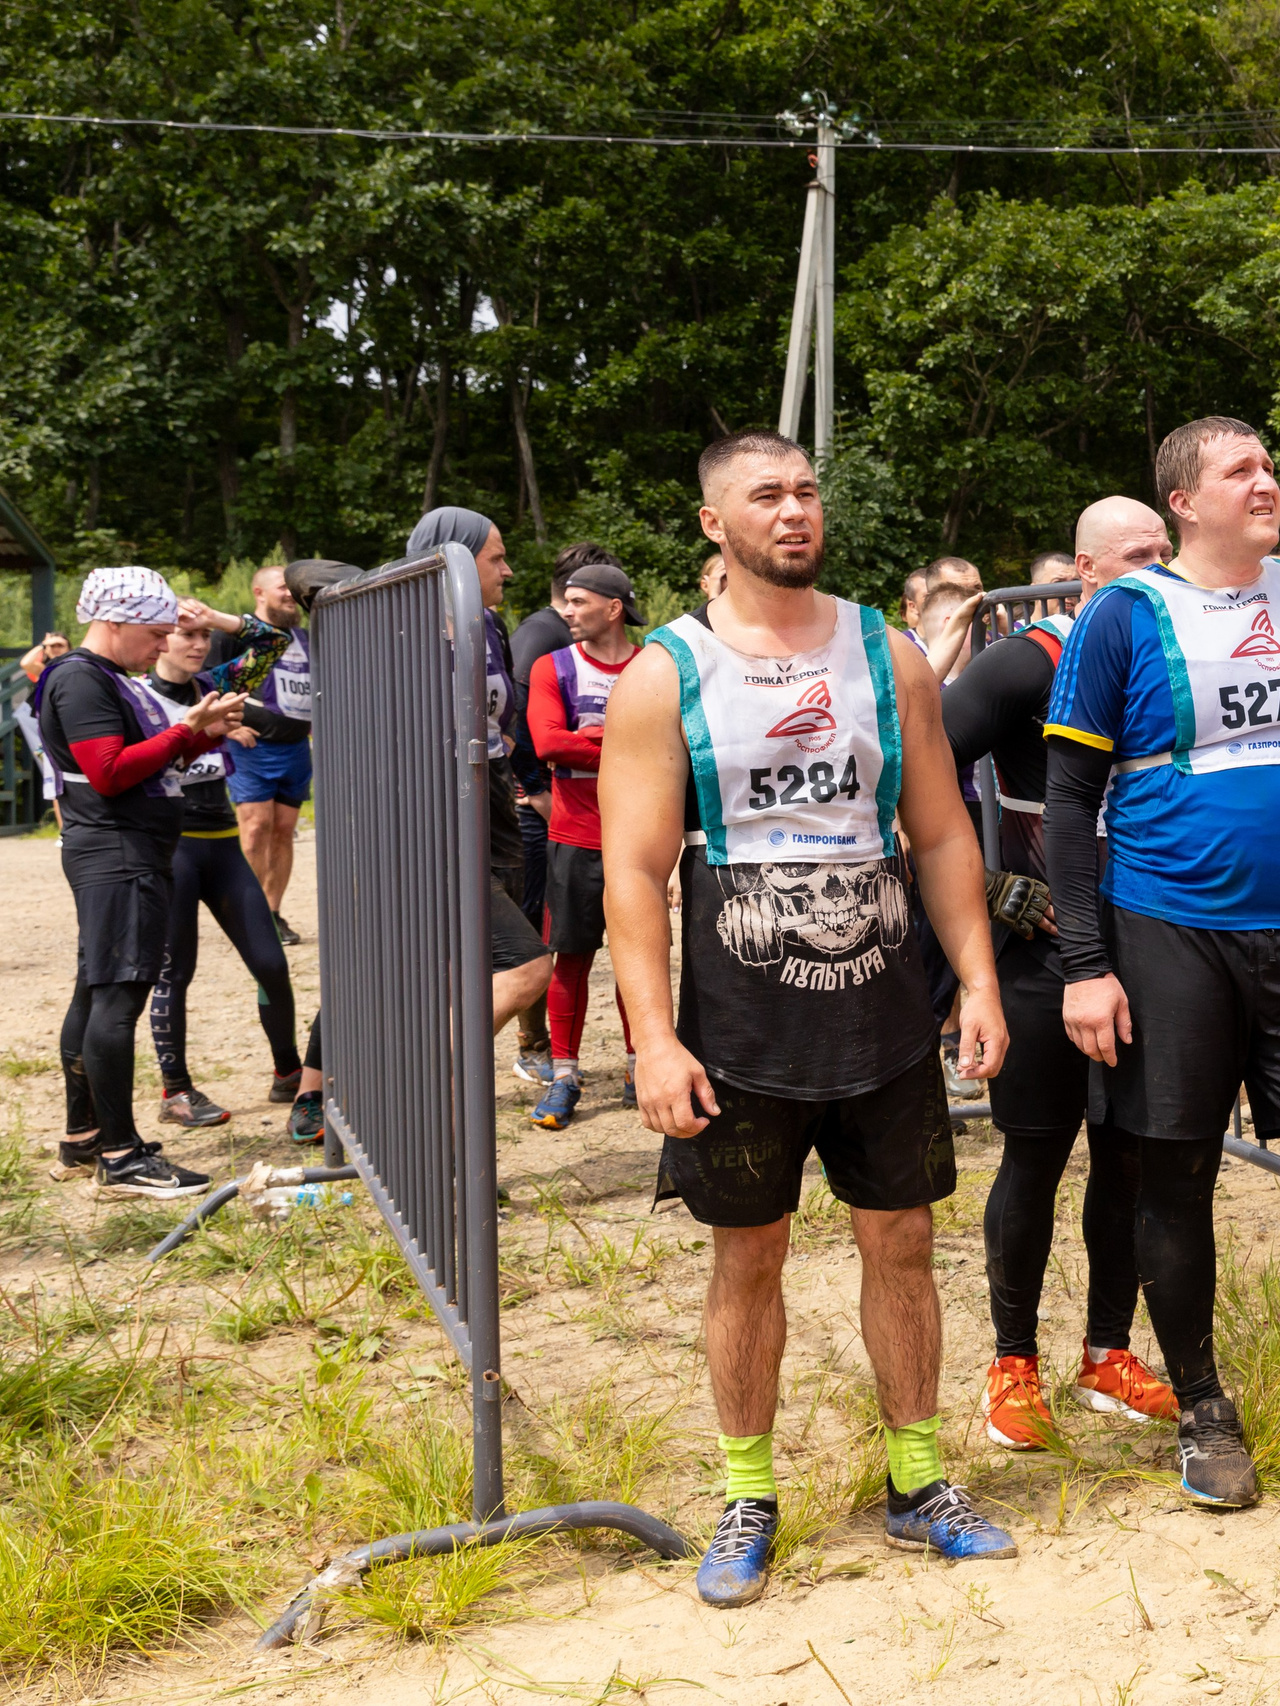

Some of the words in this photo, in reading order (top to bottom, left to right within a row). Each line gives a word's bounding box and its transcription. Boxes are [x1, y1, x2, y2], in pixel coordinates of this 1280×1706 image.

[744, 675, 784, 685] ГОНКА
[785, 666, 829, 684] ГЕРОЕВ
[794, 732, 837, 754] РОСПРОФЖЕЛ
[749, 754, 861, 811] 5284
[792, 833, 857, 845] ГАЗПРОМБАНК
[780, 944, 886, 991] КУЛЬТУРА
